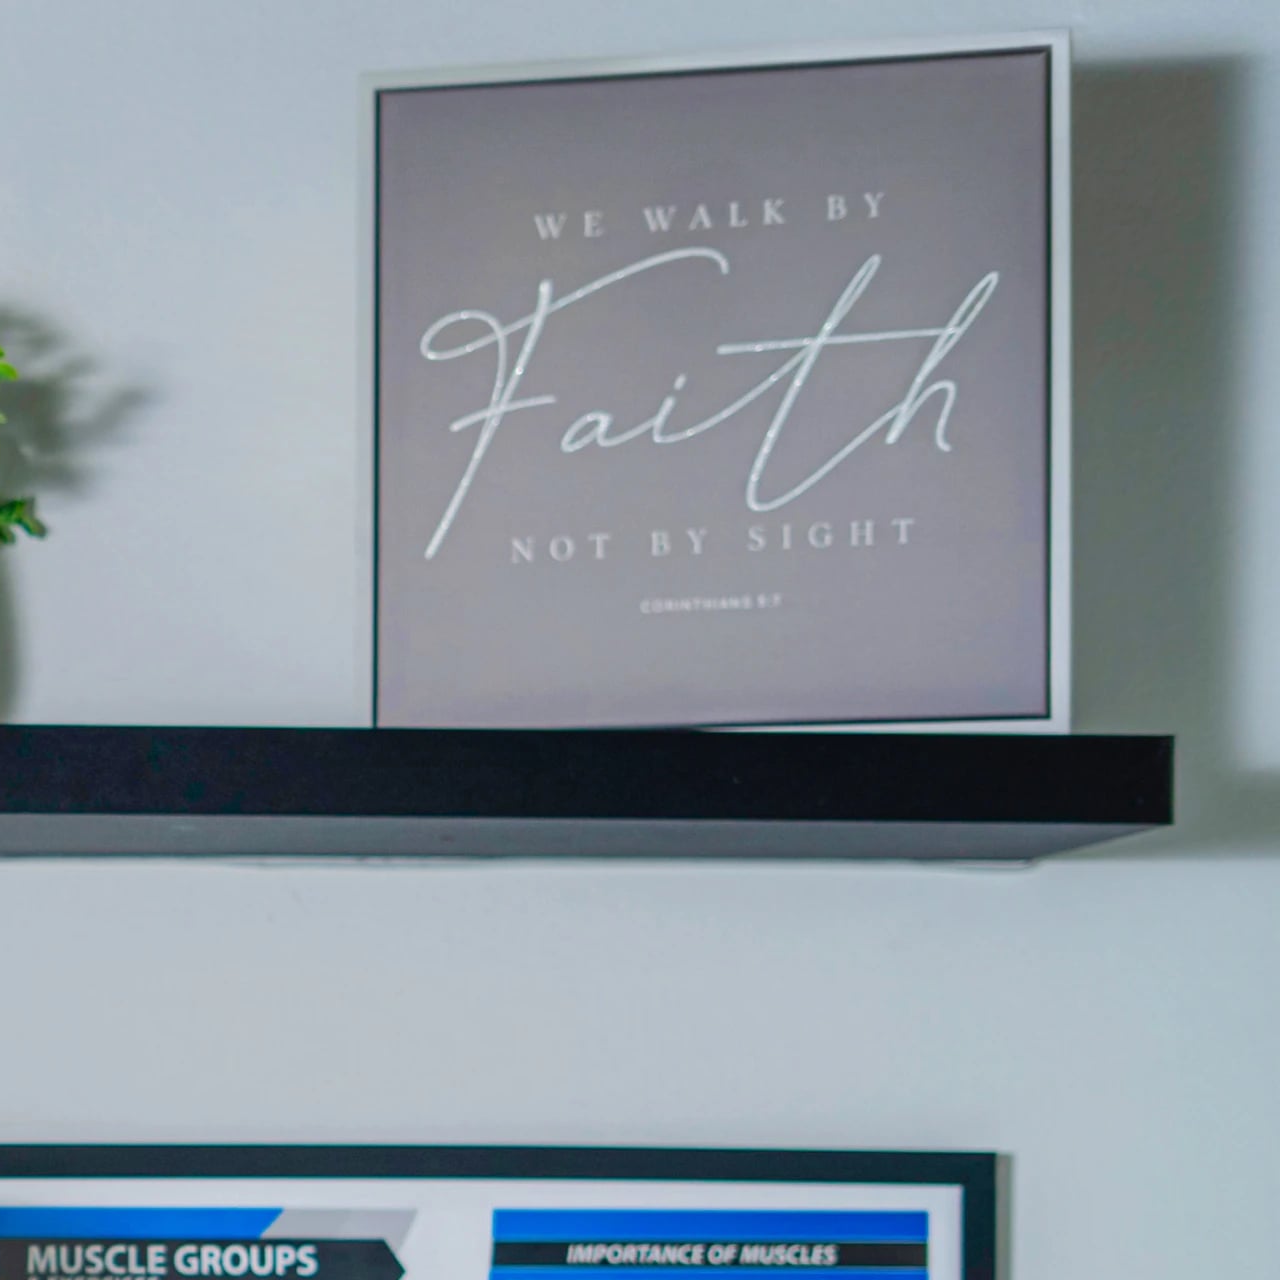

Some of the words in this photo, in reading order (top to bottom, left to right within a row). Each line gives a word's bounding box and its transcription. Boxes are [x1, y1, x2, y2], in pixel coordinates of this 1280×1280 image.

[535, 212, 605, 240] WE
[645, 199, 785, 232] WALK
[827, 191, 886, 221] BY
[420, 247, 999, 559] Faith
[511, 532, 611, 563] NOT
[651, 527, 709, 556] BY
[747, 518, 915, 552] SIGHT
[27, 1245, 167, 1275] MUSCLE
[174, 1245, 318, 1276] GROUPS
[566, 1244, 704, 1264] IMPORTANCE
[707, 1244, 739, 1264] OF
[740, 1244, 837, 1265] MUSCLES
